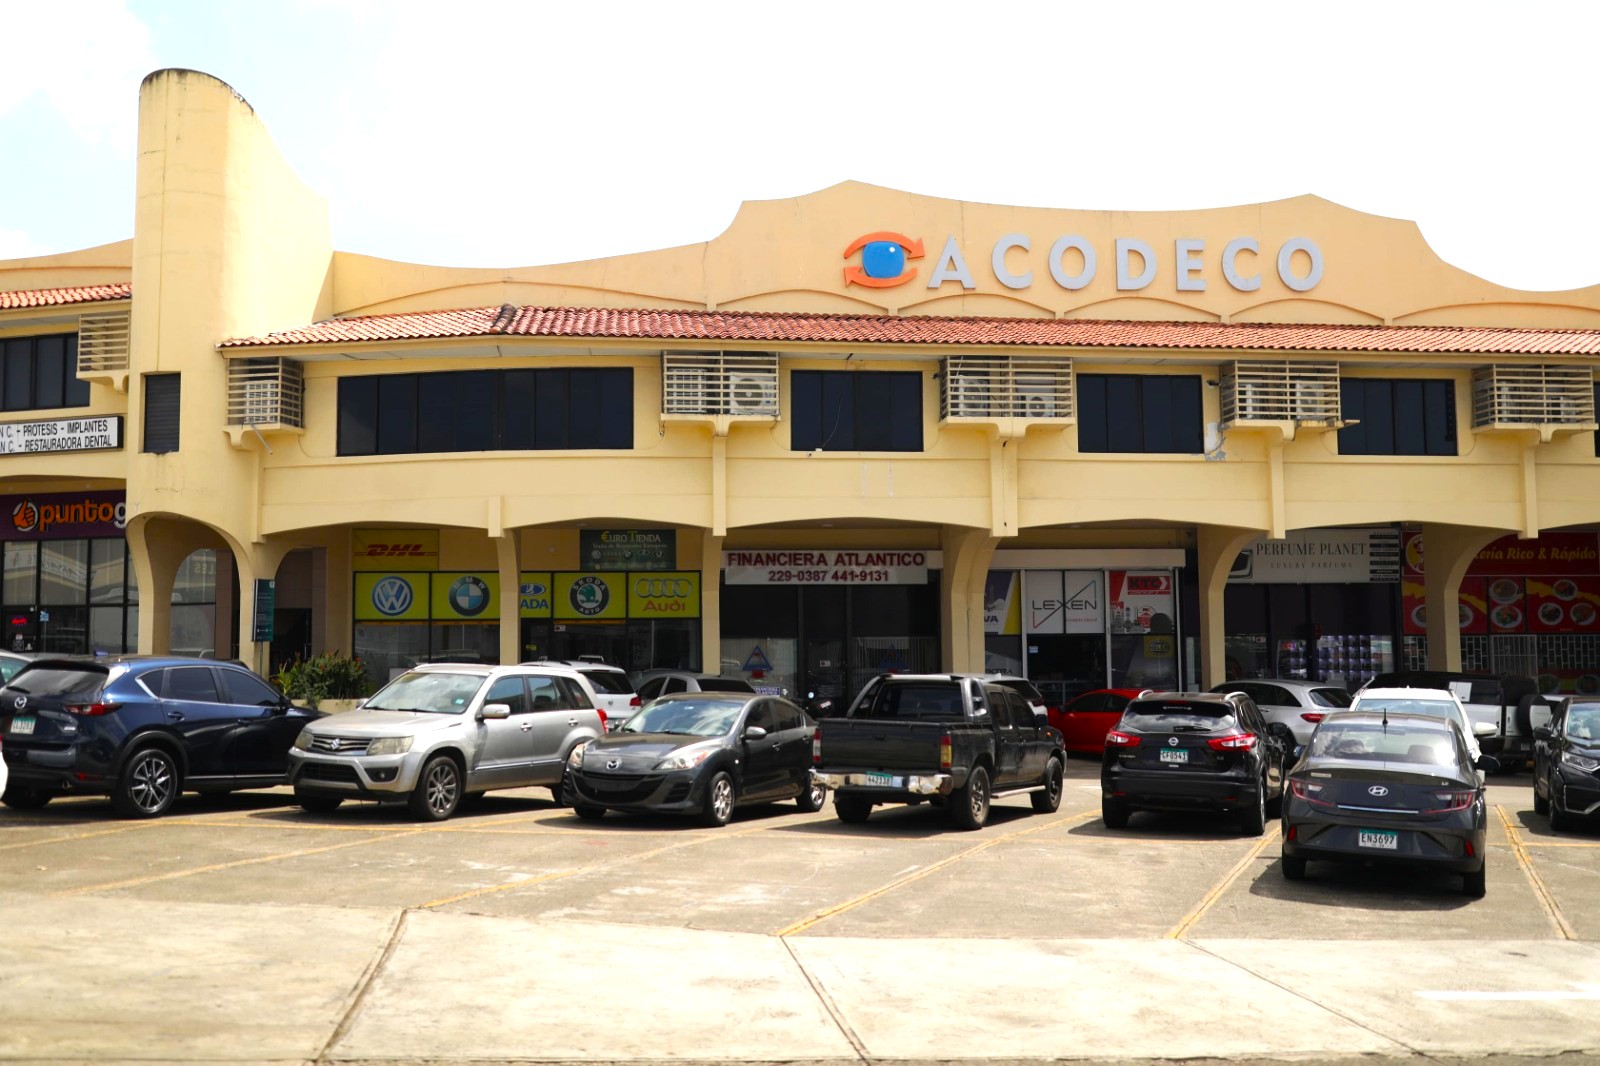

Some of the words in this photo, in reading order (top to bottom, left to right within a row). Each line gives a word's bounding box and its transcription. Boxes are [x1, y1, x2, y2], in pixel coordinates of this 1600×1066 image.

[926, 234, 1324, 293] ACODECO
[23, 423, 58, 437] PROTESIS
[67, 419, 108, 434] IMPLANTES
[25, 436, 82, 452] RESTAURADORA
[85, 434, 112, 448] DENTAL
[628, 531, 661, 542] TIENDA
[367, 544, 425, 556] DHL
[1256, 543, 1316, 555] PERFUME
[1320, 543, 1366, 555] PLANET
[1475, 546, 1504, 560] ería
[1506, 547, 1534, 559] Rico
[1538, 547, 1547, 559] &
[1550, 546, 1597, 562] Rápido
[727, 552, 828, 567] FINANCIERA
[834, 552, 925, 567] ATLANTICO
[768, 570, 828, 582] 229-0387
[831, 570, 890, 582] 441-9131
[643, 600, 686, 612] Audi
[1032, 600, 1096, 610] LEXEN
[1361, 833, 1394, 845] EN3697
